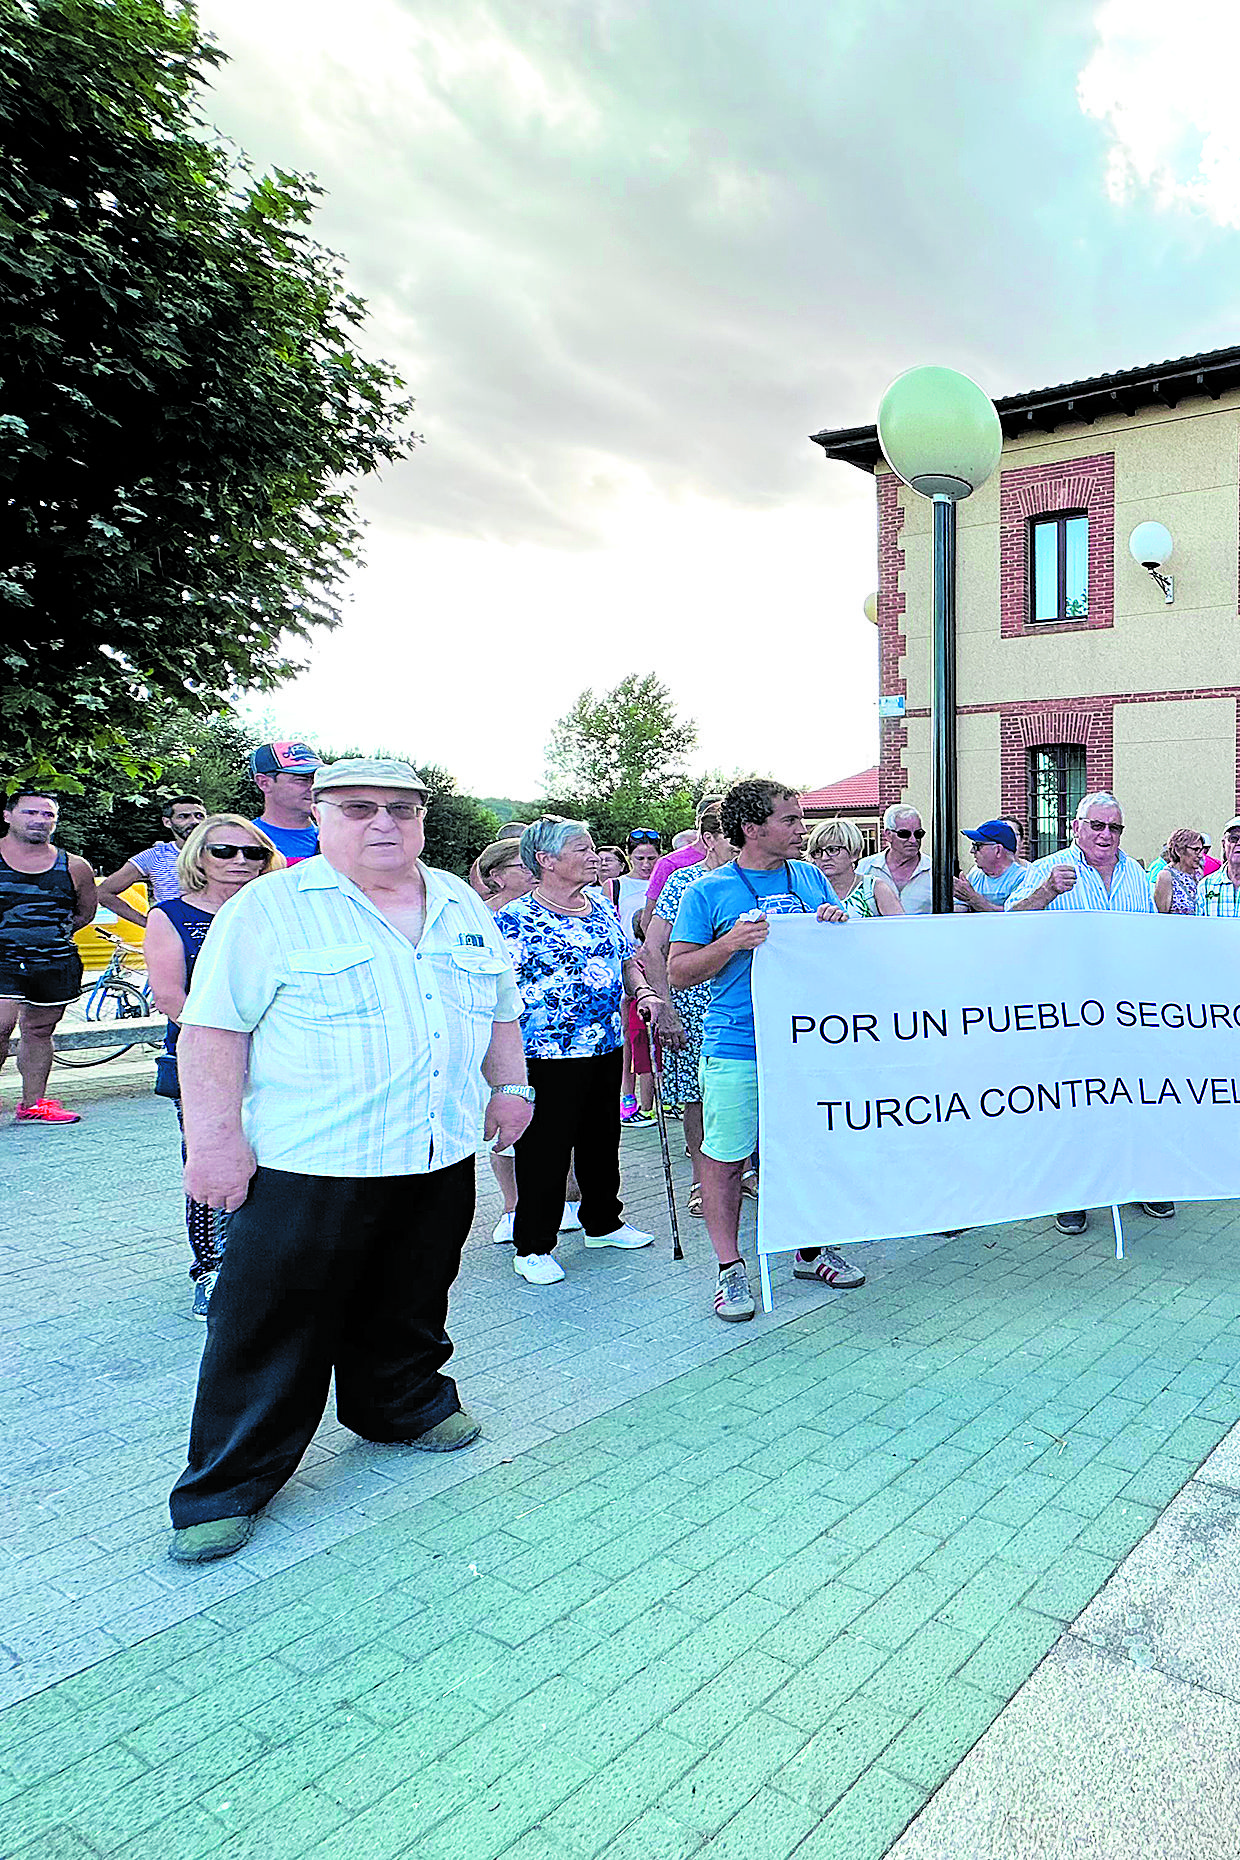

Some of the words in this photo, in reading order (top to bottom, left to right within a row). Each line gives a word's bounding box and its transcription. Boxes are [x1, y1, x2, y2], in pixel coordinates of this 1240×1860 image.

[791, 1014, 881, 1045] POR
[893, 1008, 948, 1042] UN
[961, 999, 1105, 1036] PUEBLO
[816, 1092, 972, 1131] TURCIA
[980, 1077, 1134, 1118] CONTRA
[1138, 1077, 1182, 1105] LA
